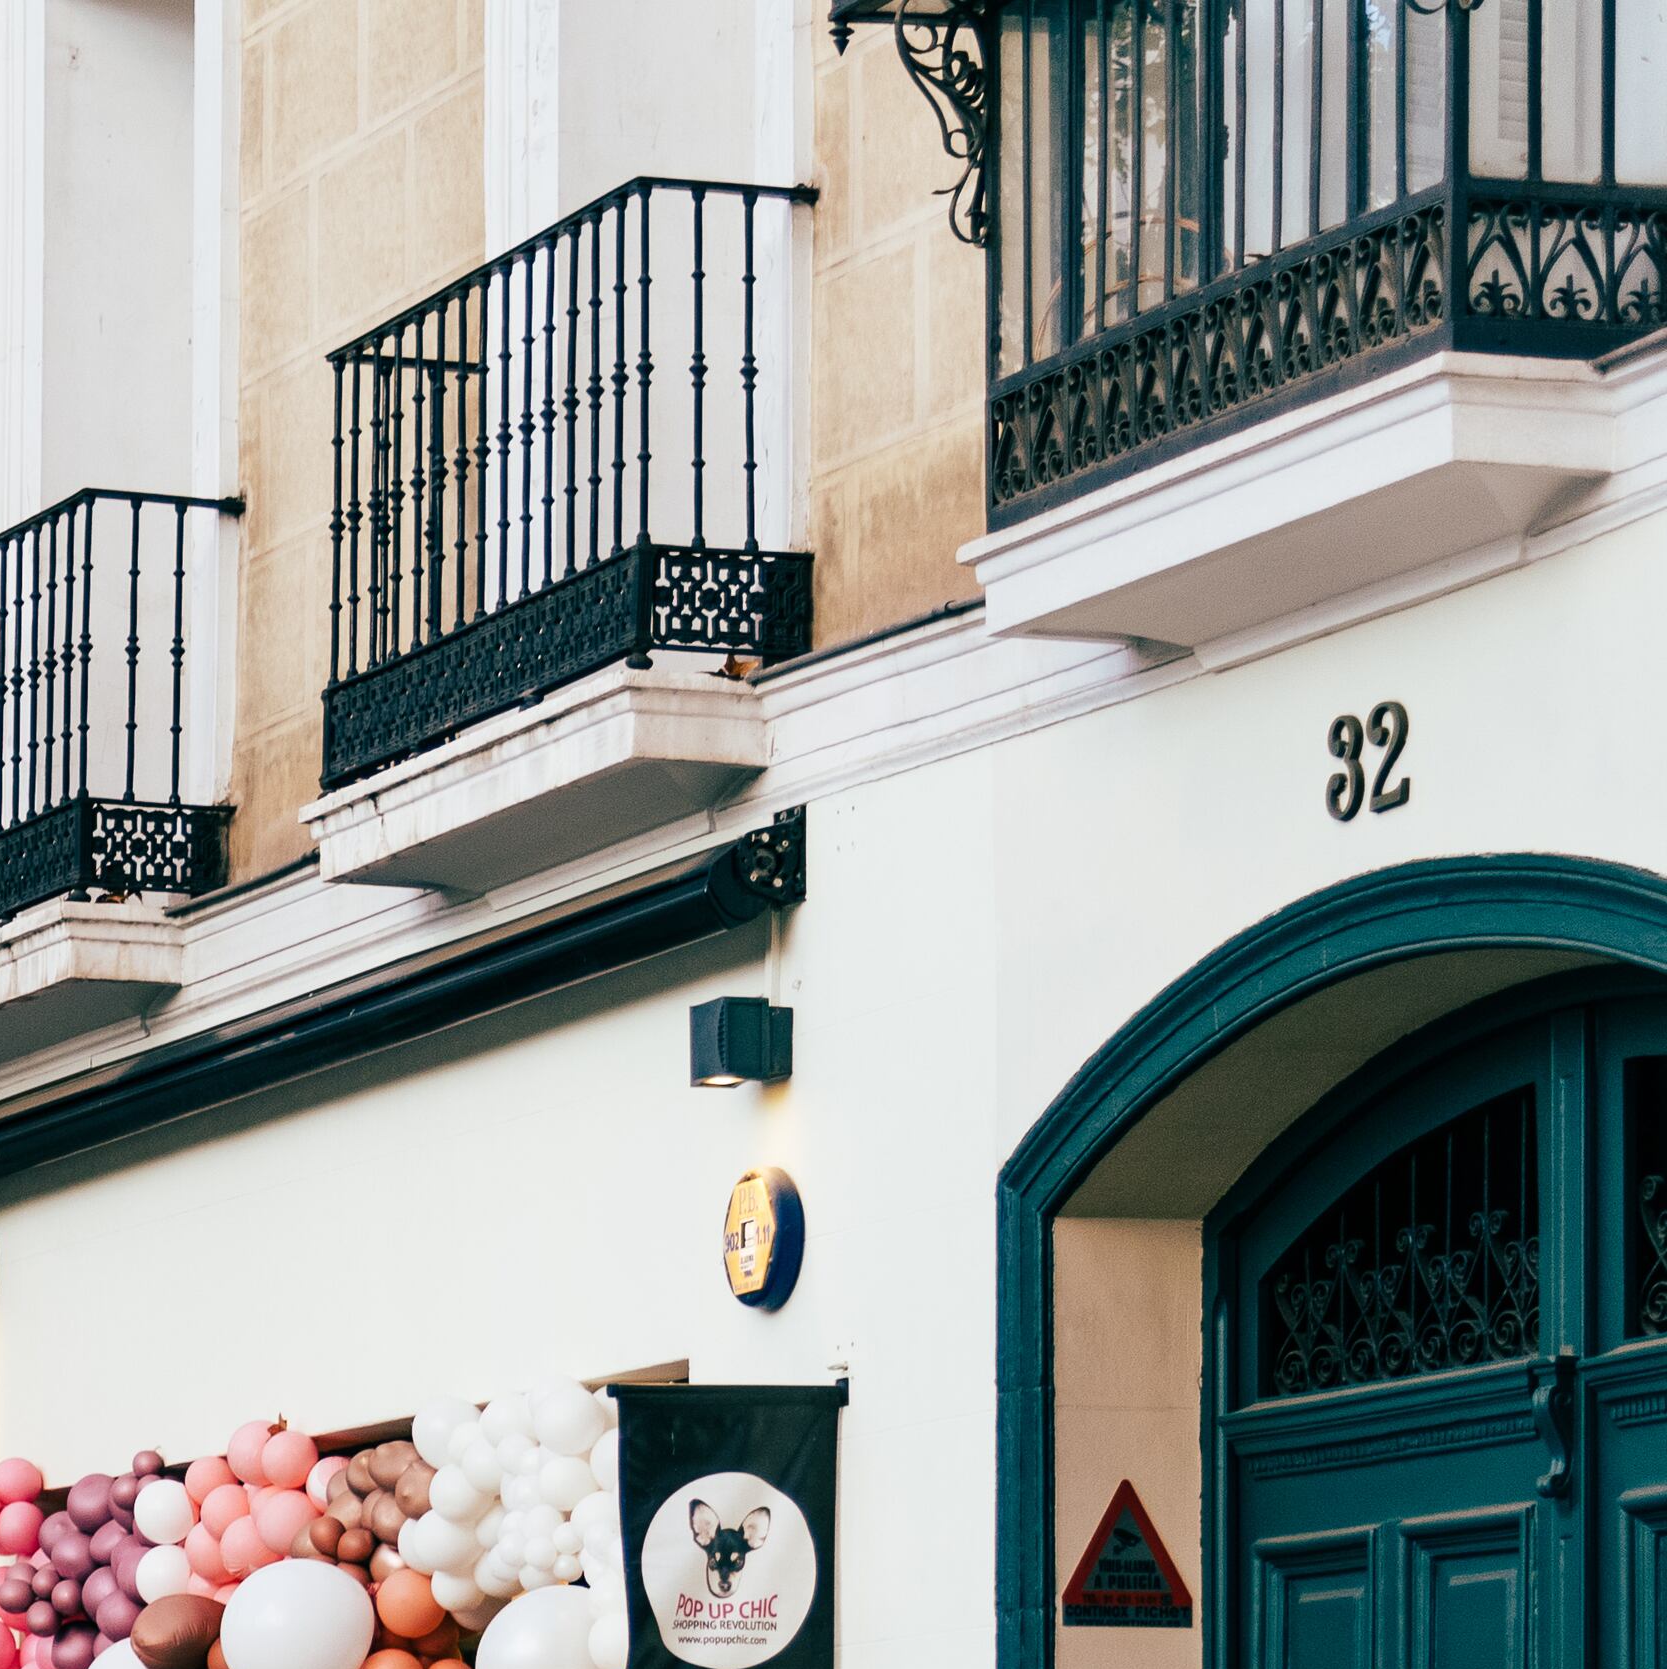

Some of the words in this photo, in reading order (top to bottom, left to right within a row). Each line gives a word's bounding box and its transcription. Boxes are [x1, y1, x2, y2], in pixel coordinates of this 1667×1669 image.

[1326, 701, 1410, 822] 32
[676, 1593, 703, 1618] POP
[709, 1602, 734, 1619] UP
[739, 1594, 778, 1619] CHIC
[673, 1619, 717, 1630] SHOPPING
[720, 1620, 777, 1631] REVOLUTION
[677, 1635, 767, 1646] www.popupchic.com
